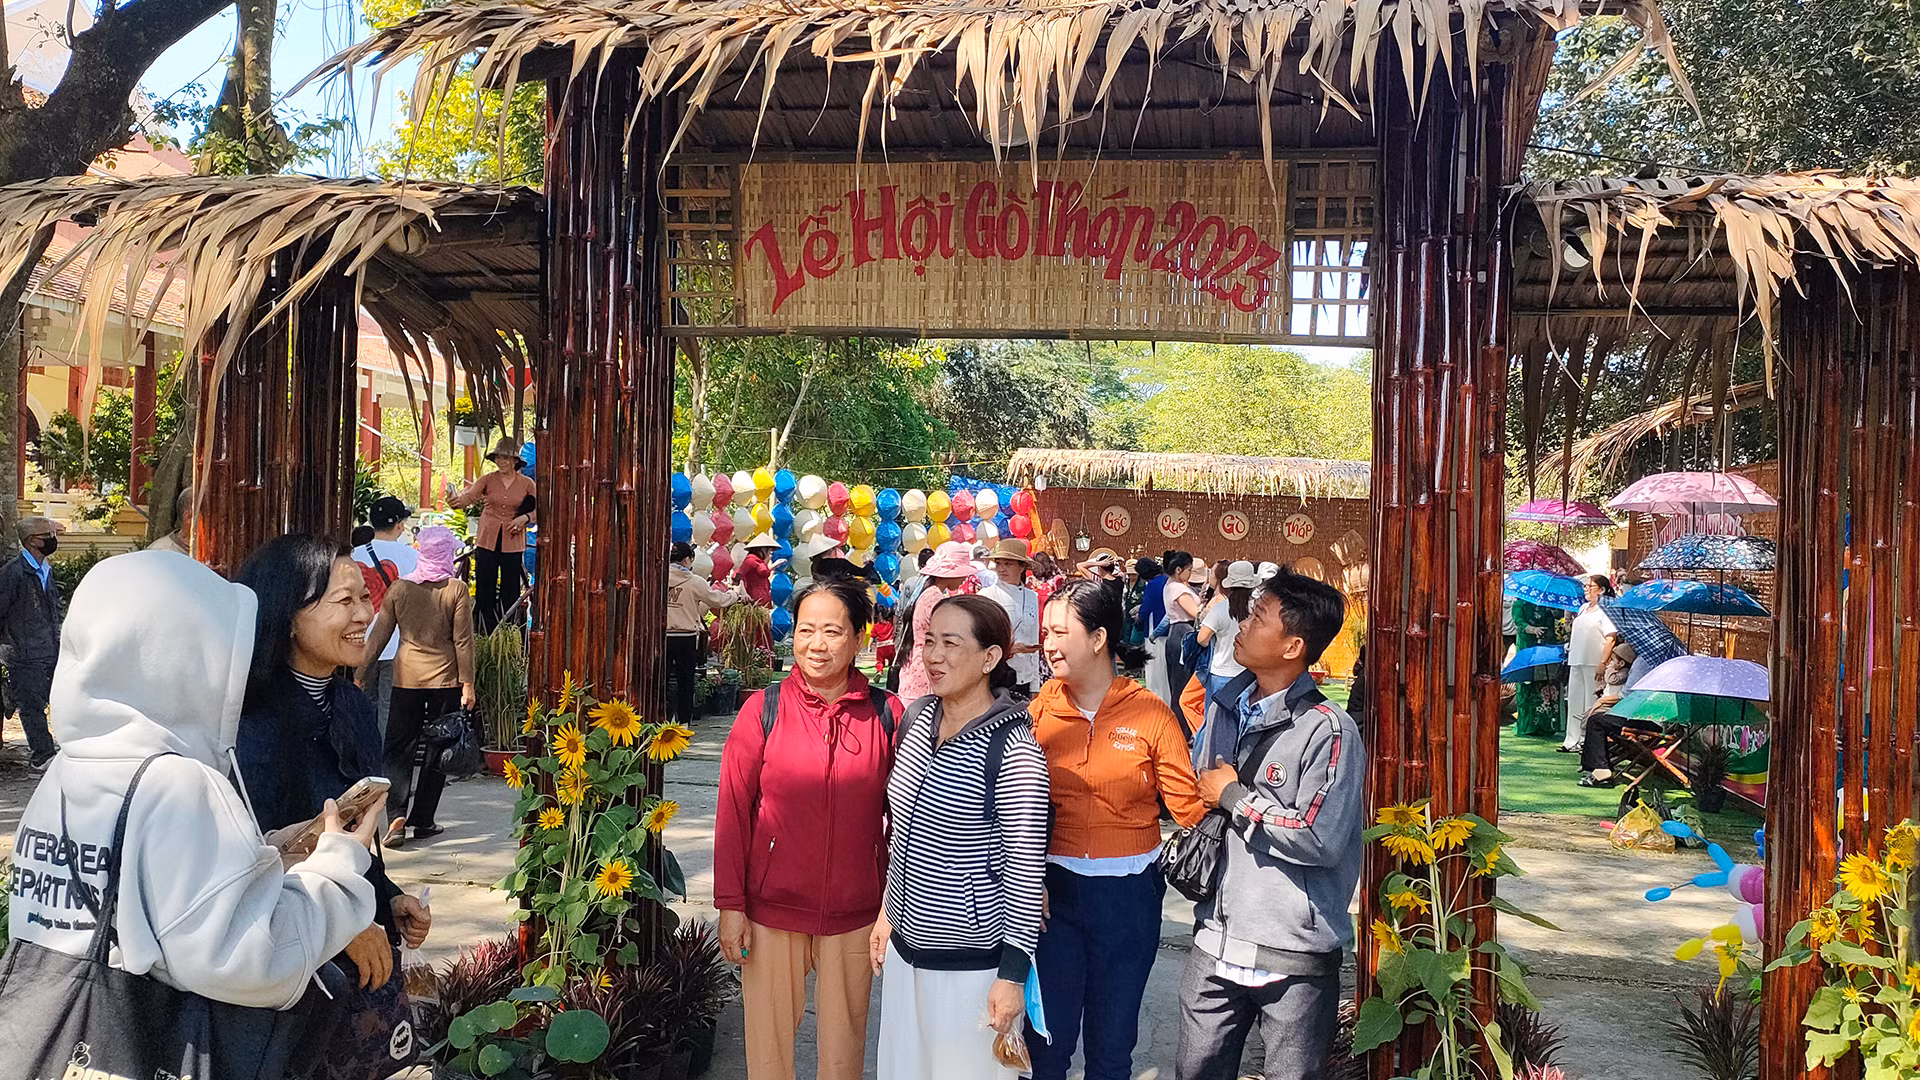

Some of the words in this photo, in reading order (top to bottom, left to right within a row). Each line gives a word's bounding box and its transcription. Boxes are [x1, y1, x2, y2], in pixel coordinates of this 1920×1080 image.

[743, 199, 846, 315] Lễ
[844, 184, 956, 276] Hội
[963, 180, 1031, 260] Gò
[1032, 180, 1155, 280] Tháp
[1151, 200, 1281, 312] 2023
[1104, 511, 1128, 532] Gốc
[1161, 514, 1186, 534] Quê
[1221, 514, 1246, 534] Gò
[1285, 517, 1313, 539] Tháp
